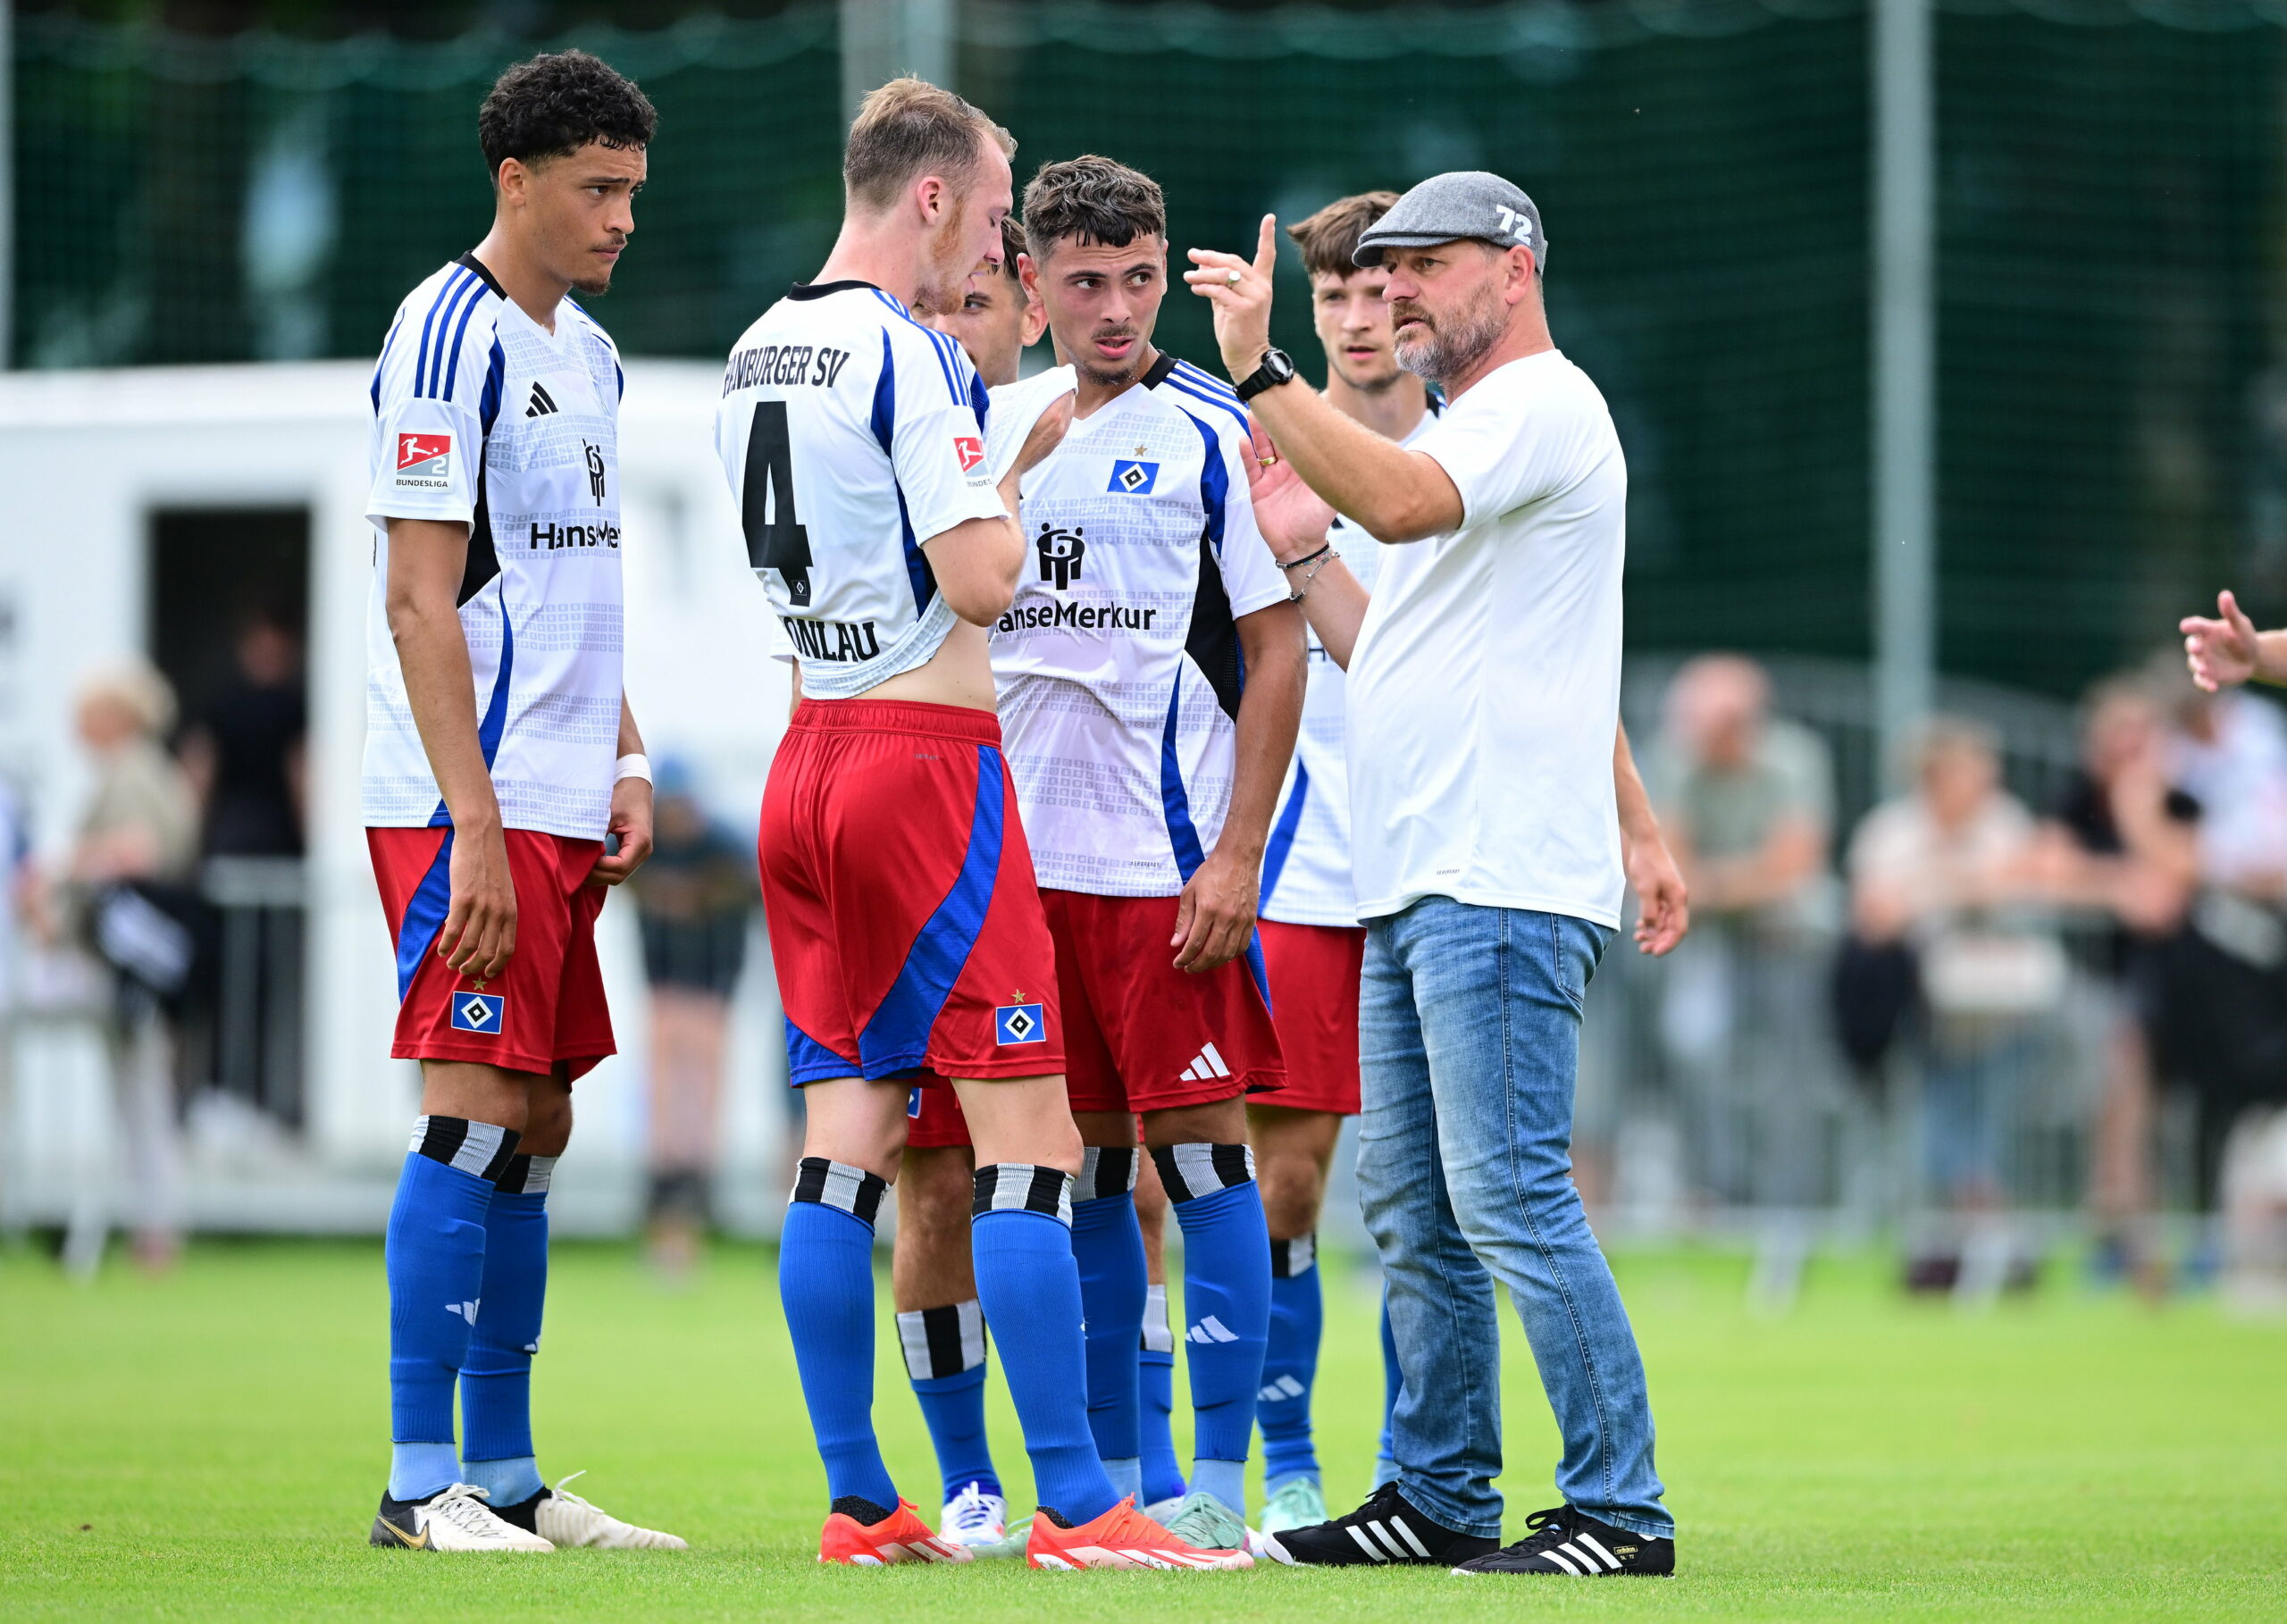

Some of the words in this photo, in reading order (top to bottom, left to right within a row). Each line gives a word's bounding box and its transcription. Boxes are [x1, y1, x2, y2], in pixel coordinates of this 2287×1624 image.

[1495, 204, 1533, 247] 72
[811, 347, 850, 388] SV
[396, 479, 448, 488] BUNDESLIGA
[431, 456, 447, 474] 2
[741, 400, 814, 607] 4
[996, 599, 1157, 633] anseMerkur
